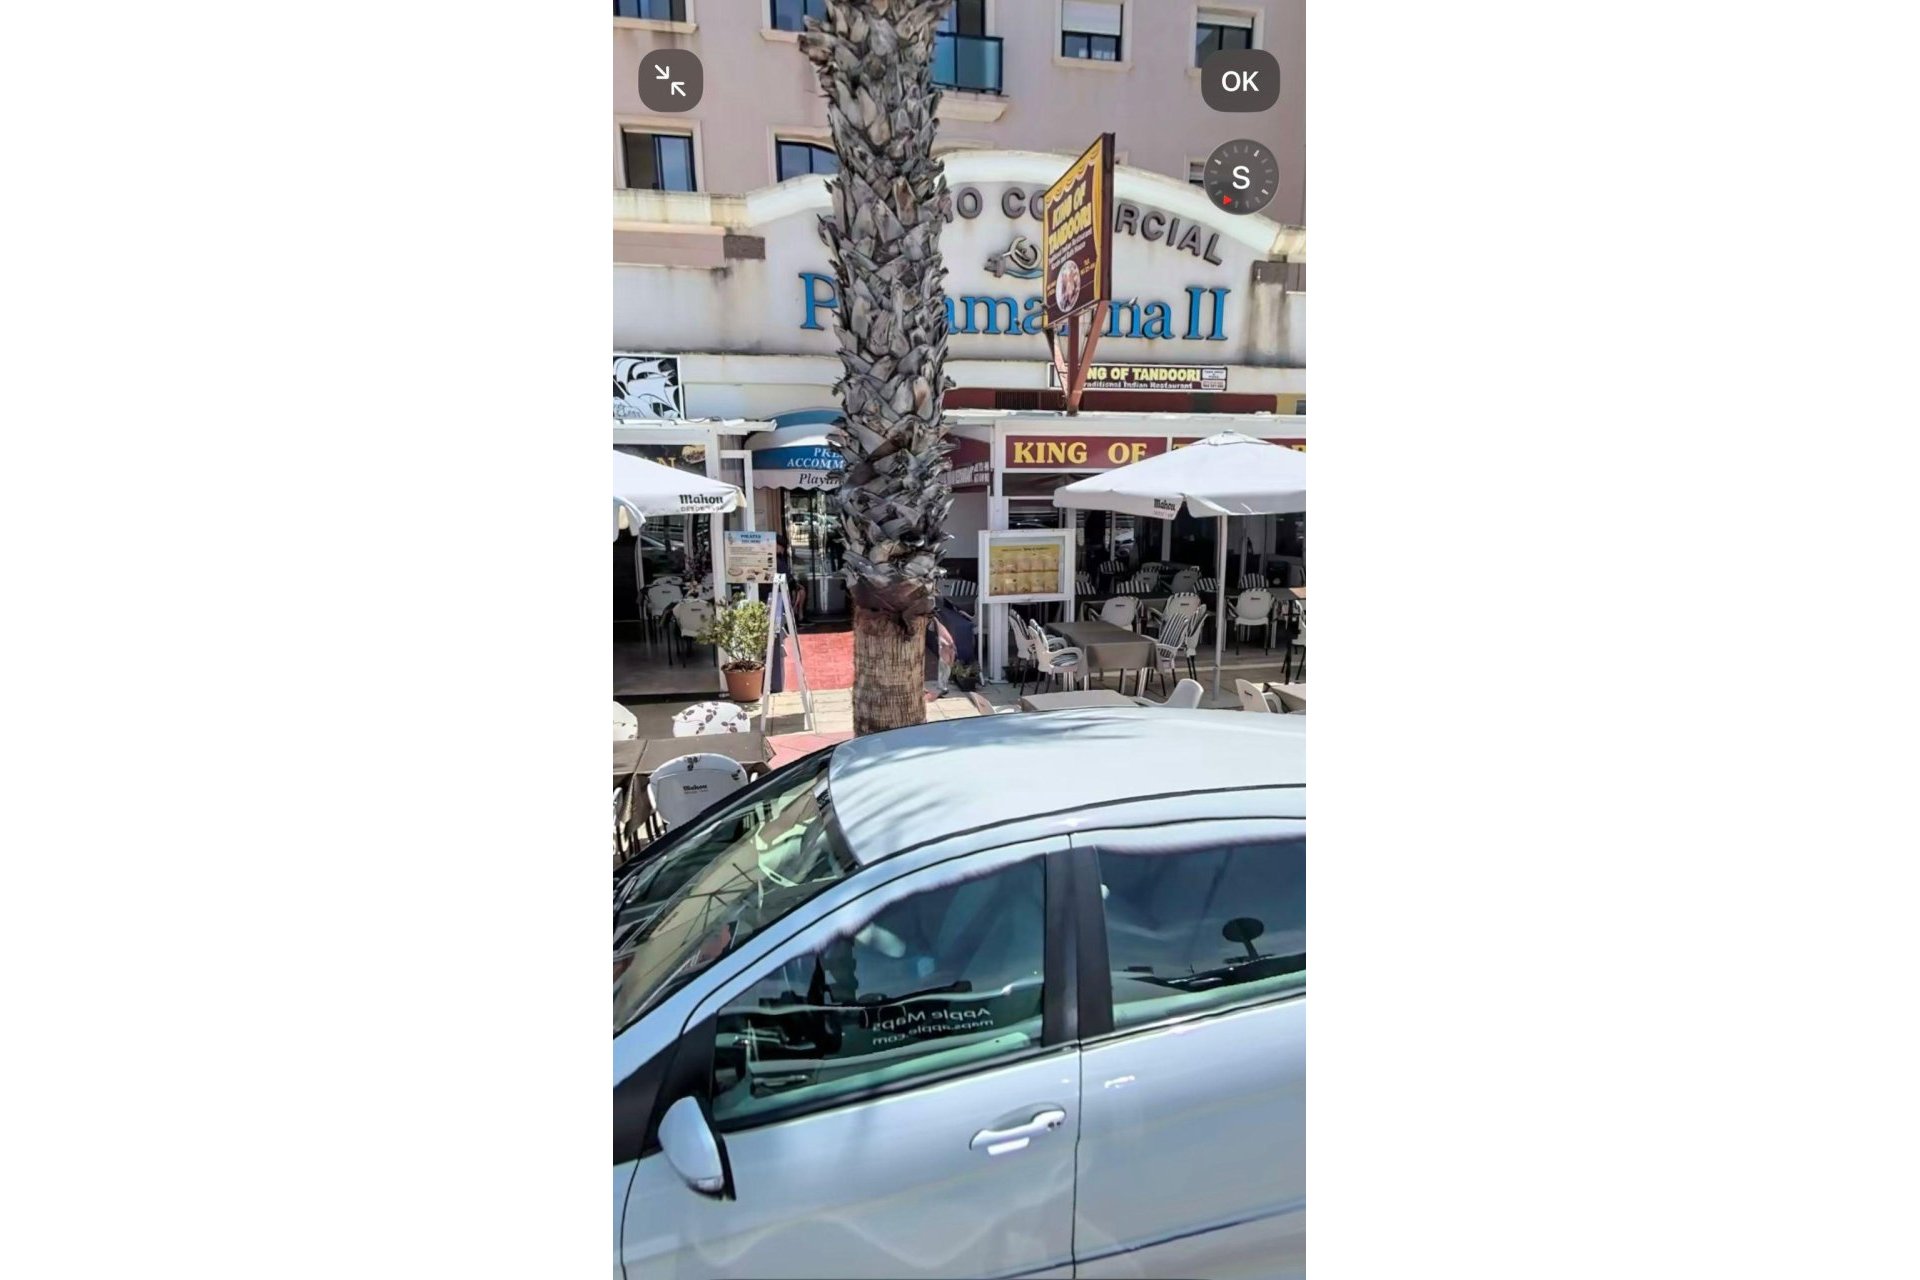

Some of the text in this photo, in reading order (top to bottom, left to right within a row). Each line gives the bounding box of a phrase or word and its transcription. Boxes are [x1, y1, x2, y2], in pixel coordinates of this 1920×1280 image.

[1073, 180, 1087, 211] OF
[1001, 186, 1223, 267] CORCIAL
[1048, 202, 1092, 256] TANDOORI
[1182, 286, 1231, 341] II
[1083, 380, 1121, 388] raditional
[1087, 367, 1107, 380] NG
[1110, 367, 1129, 380] OF
[1131, 368, 1201, 382] TANDOORI
[1014, 442, 1147, 464] KING OF
